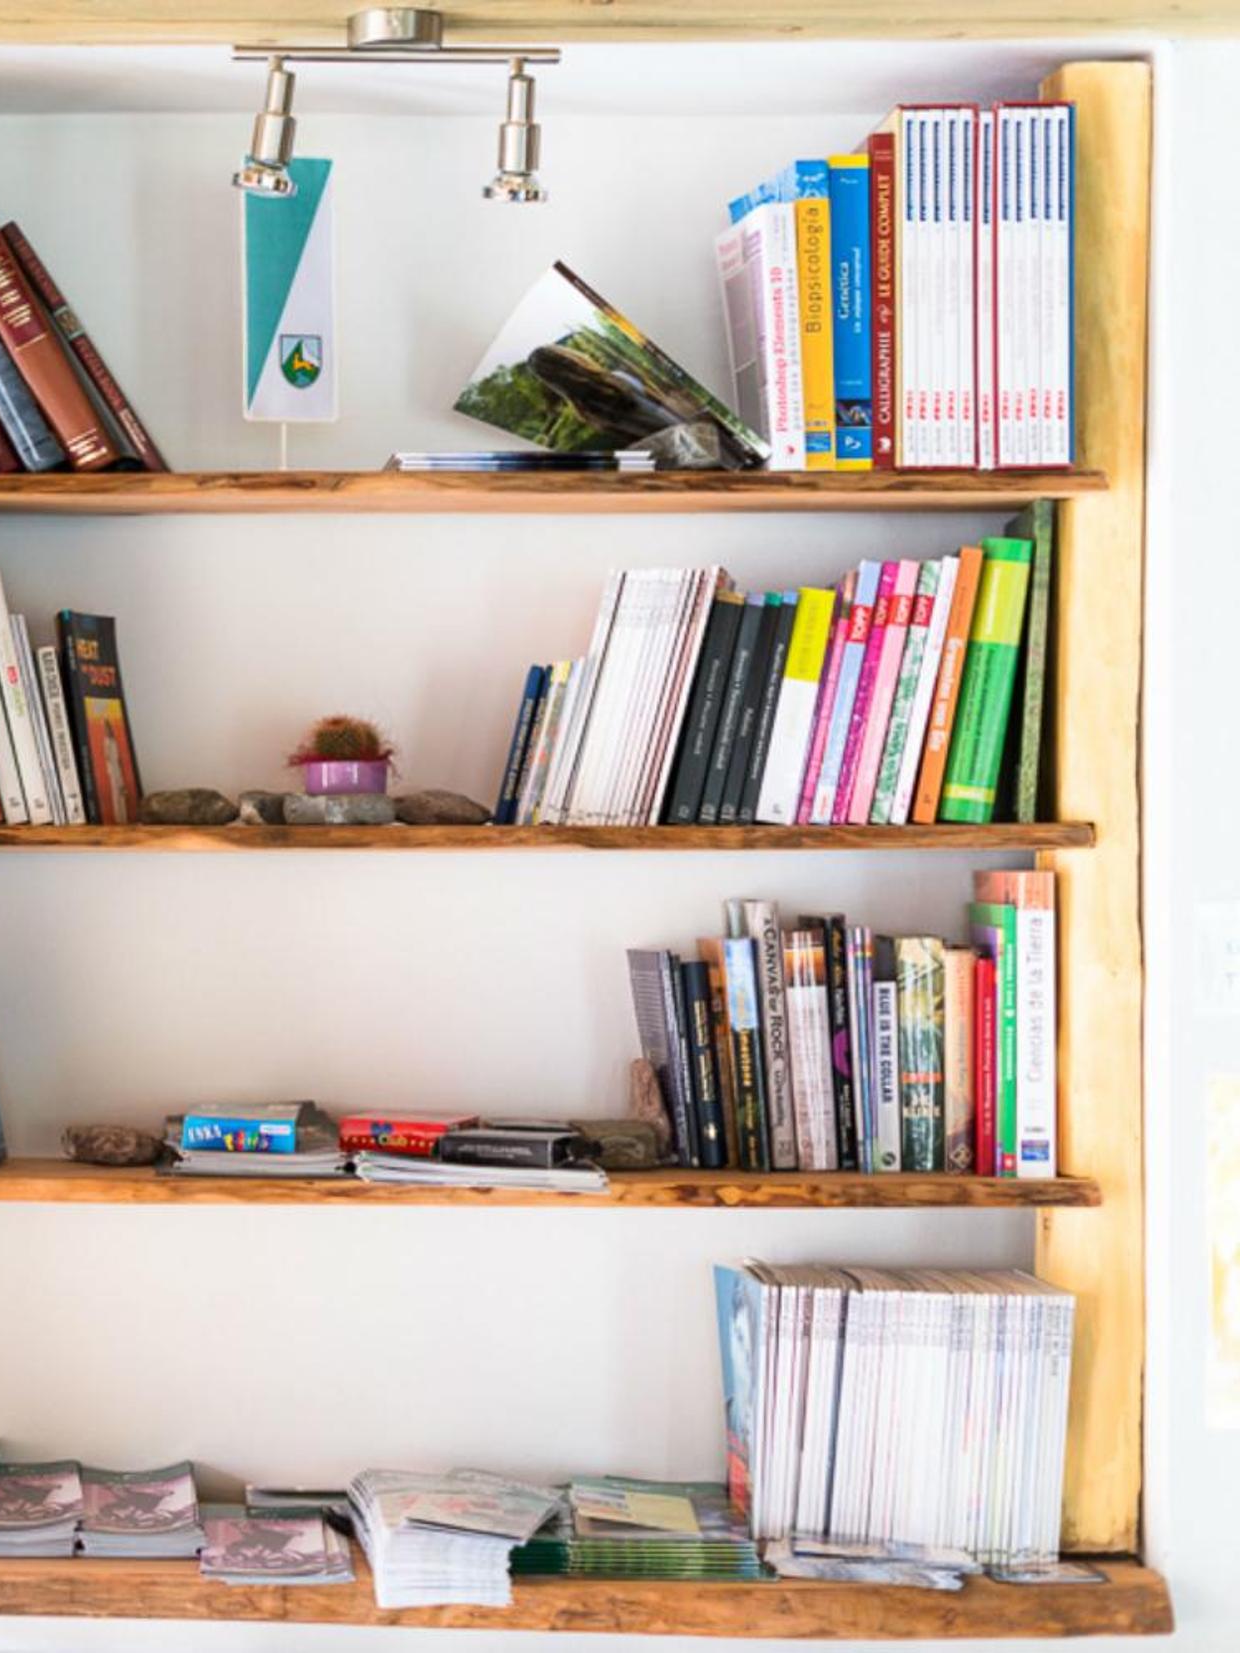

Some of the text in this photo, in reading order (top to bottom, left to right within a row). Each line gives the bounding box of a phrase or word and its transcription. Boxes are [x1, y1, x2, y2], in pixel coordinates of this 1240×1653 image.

[800, 206, 826, 334] Biopsicología
[876, 173, 892, 424] CALLIGRAPHIE LE GUIDE COMPLET
[762, 927, 781, 994] CANVAS
[1026, 917, 1043, 962] Tierra
[1026, 992, 1043, 1012] de
[769, 1015, 785, 1061] ROCK
[878, 987, 892, 1103] BLUE IS THE COLLAR
[1026, 1015, 1043, 1082] Ciencias
